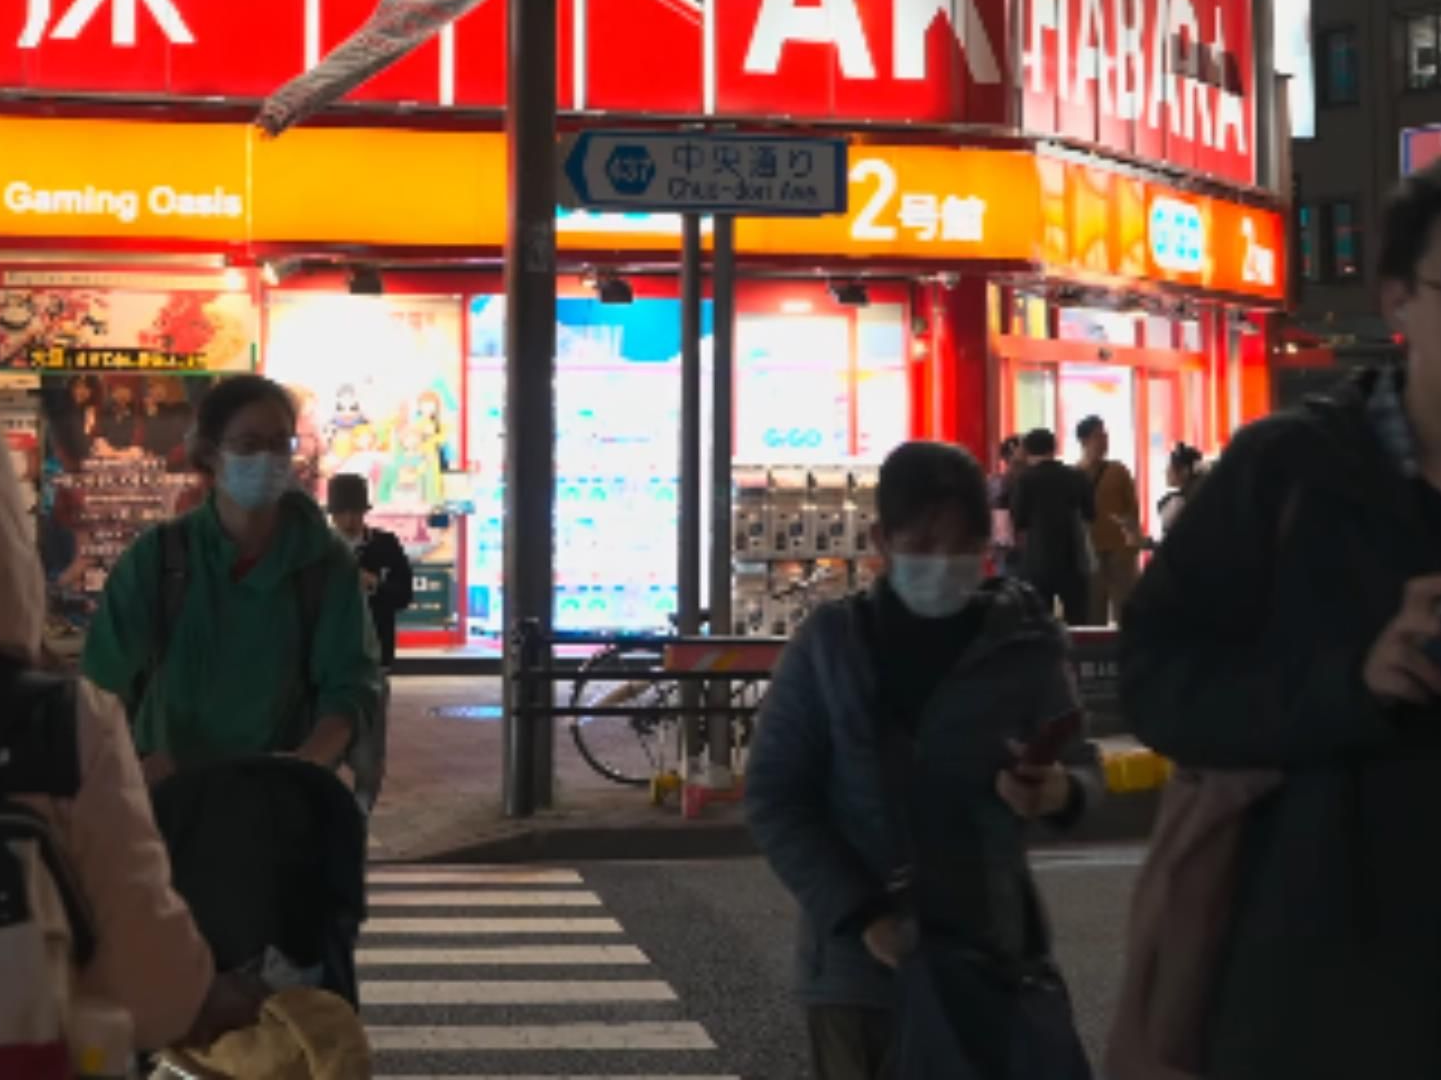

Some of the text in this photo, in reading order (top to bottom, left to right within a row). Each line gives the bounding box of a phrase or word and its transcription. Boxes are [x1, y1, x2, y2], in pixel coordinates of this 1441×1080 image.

[671, 142, 813, 179] 中央通り
[4, 183, 138, 222] Gaming
[149, 186, 242, 217] Oasis
